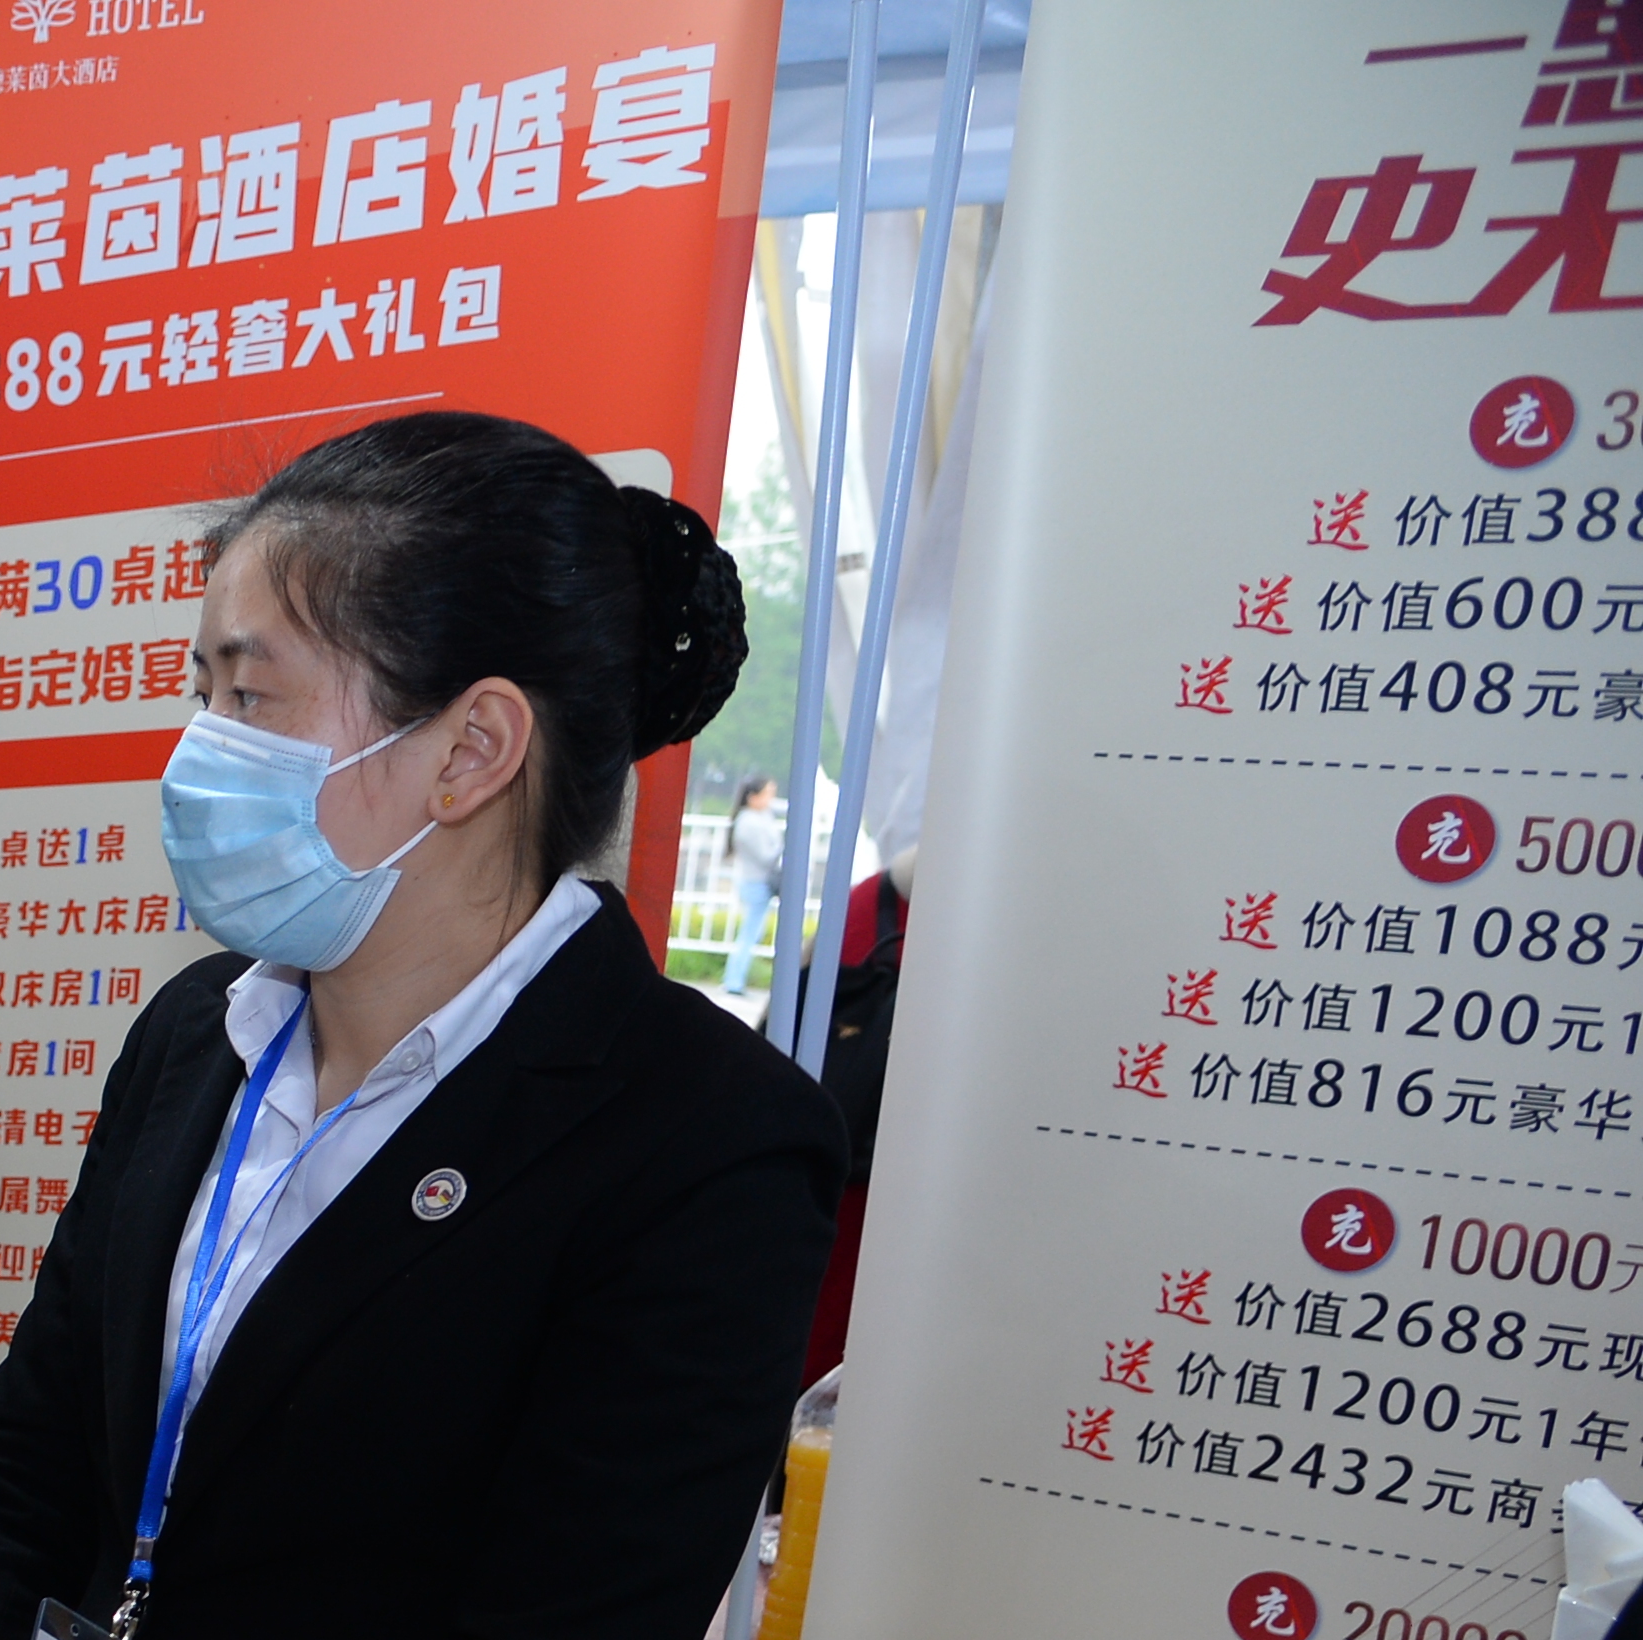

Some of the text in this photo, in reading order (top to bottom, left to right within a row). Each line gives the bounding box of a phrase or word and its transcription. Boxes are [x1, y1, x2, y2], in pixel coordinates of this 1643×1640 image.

[86, 0, 205, 37] HOTEL
[1495, 391, 1643, 451] 充 3
[1307, 488, 1371, 551] 送
[1233, 574, 1643, 634] 送 价值600元
[1175, 654, 1643, 722] 送 价值408元豪
[1420, 810, 1643, 878] 充 500
[1219, 892, 1278, 949] 送
[1162, 968, 1218, 1026] 送
[1112, 1042, 1169, 1098] 送
[1327, 1203, 1372, 1256] 充
[1155, 1269, 1212, 1326] 送
[1099, 1339, 1155, 1394] 送
[1062, 1407, 1566, 1536] 送 价值2432元商
[1249, 1586, 1297, 1637] 充
